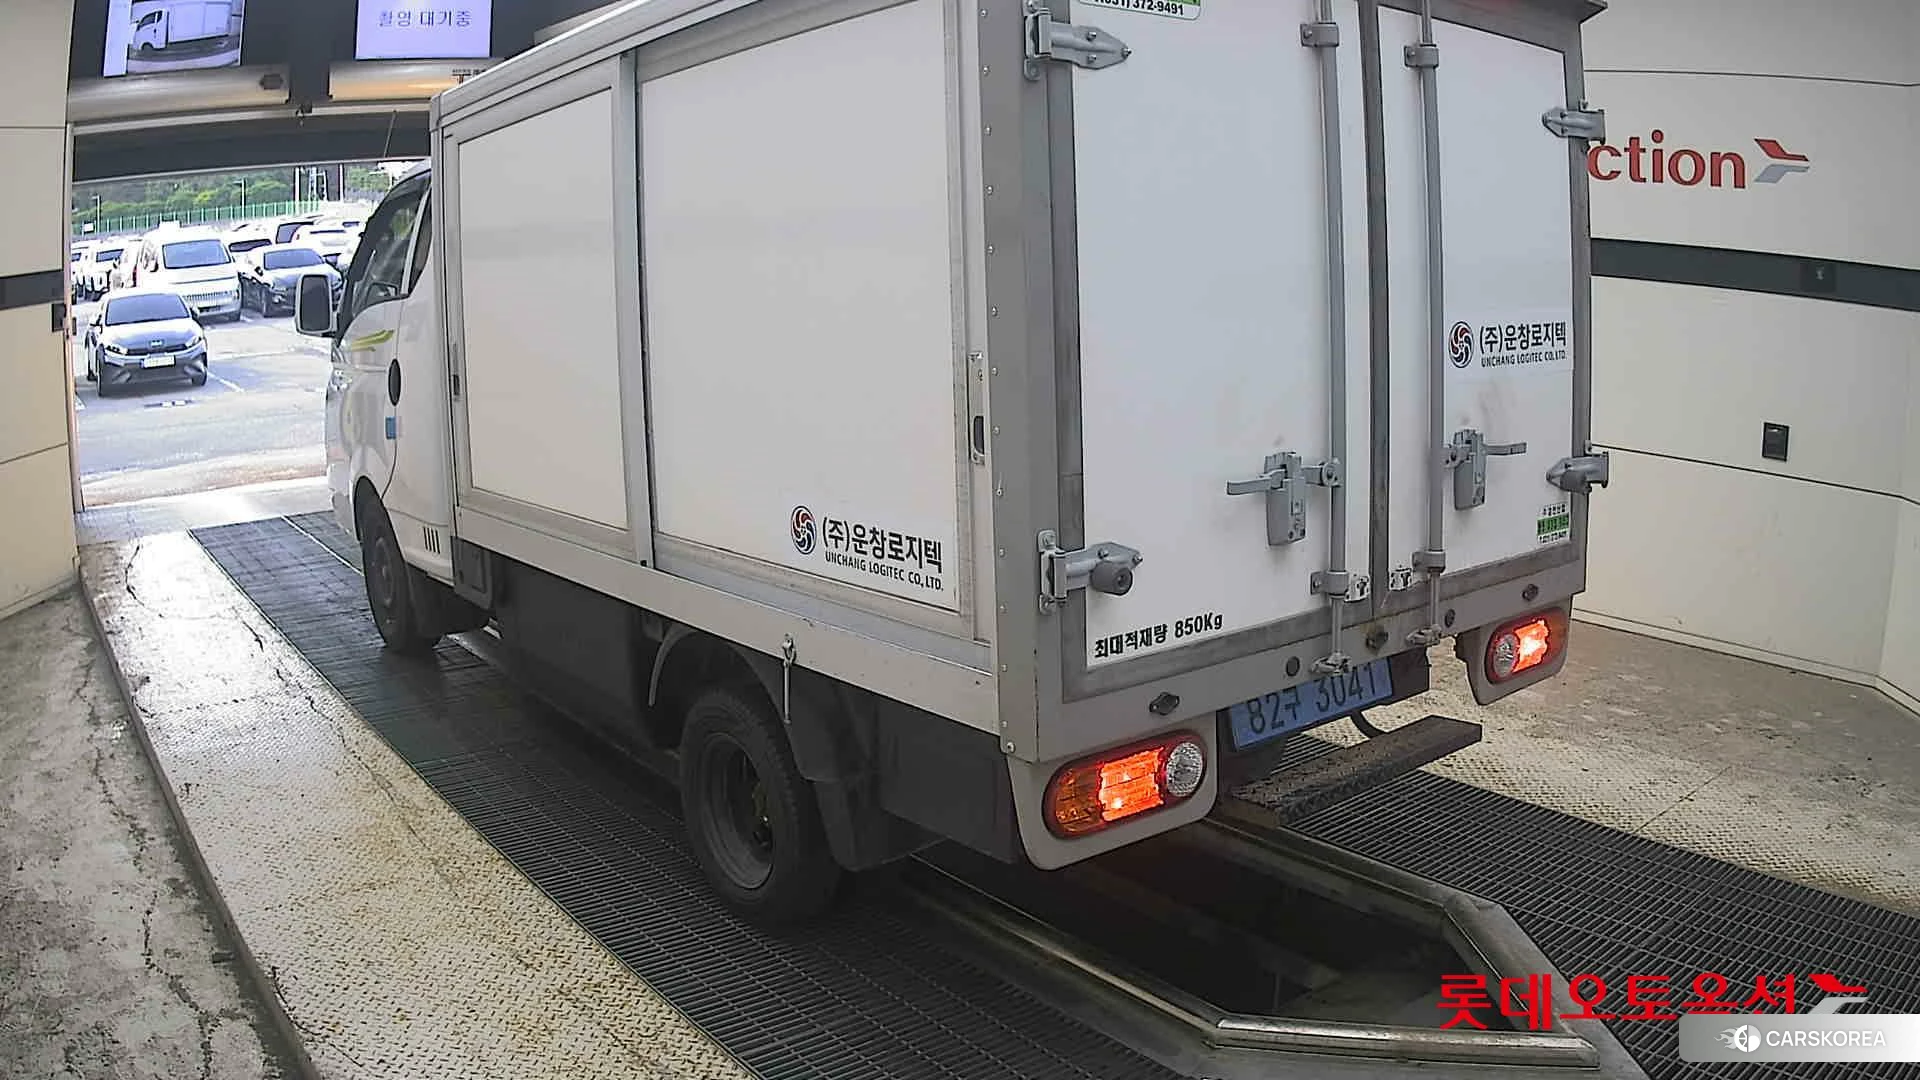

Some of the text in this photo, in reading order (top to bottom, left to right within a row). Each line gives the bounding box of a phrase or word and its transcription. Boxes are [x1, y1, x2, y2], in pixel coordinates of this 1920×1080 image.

[420, 10, 473, 27] 대기중
[1587, 129, 1746, 189] ction
[1480, 322, 1566, 354] (주)운창로지텍
[1481, 354, 1515, 368] UNCHANG
[1517, 352, 1543, 364] LOGITEC
[822, 516, 942, 574] (주)운창로지텍
[825, 551, 866, 571] UNCHANG
[869, 561, 905, 581] LOGITEC
[1095, 612, 1223, 658] 최대적재량 850Kg
[1247, 662, 1376, 734] 82구 3041
